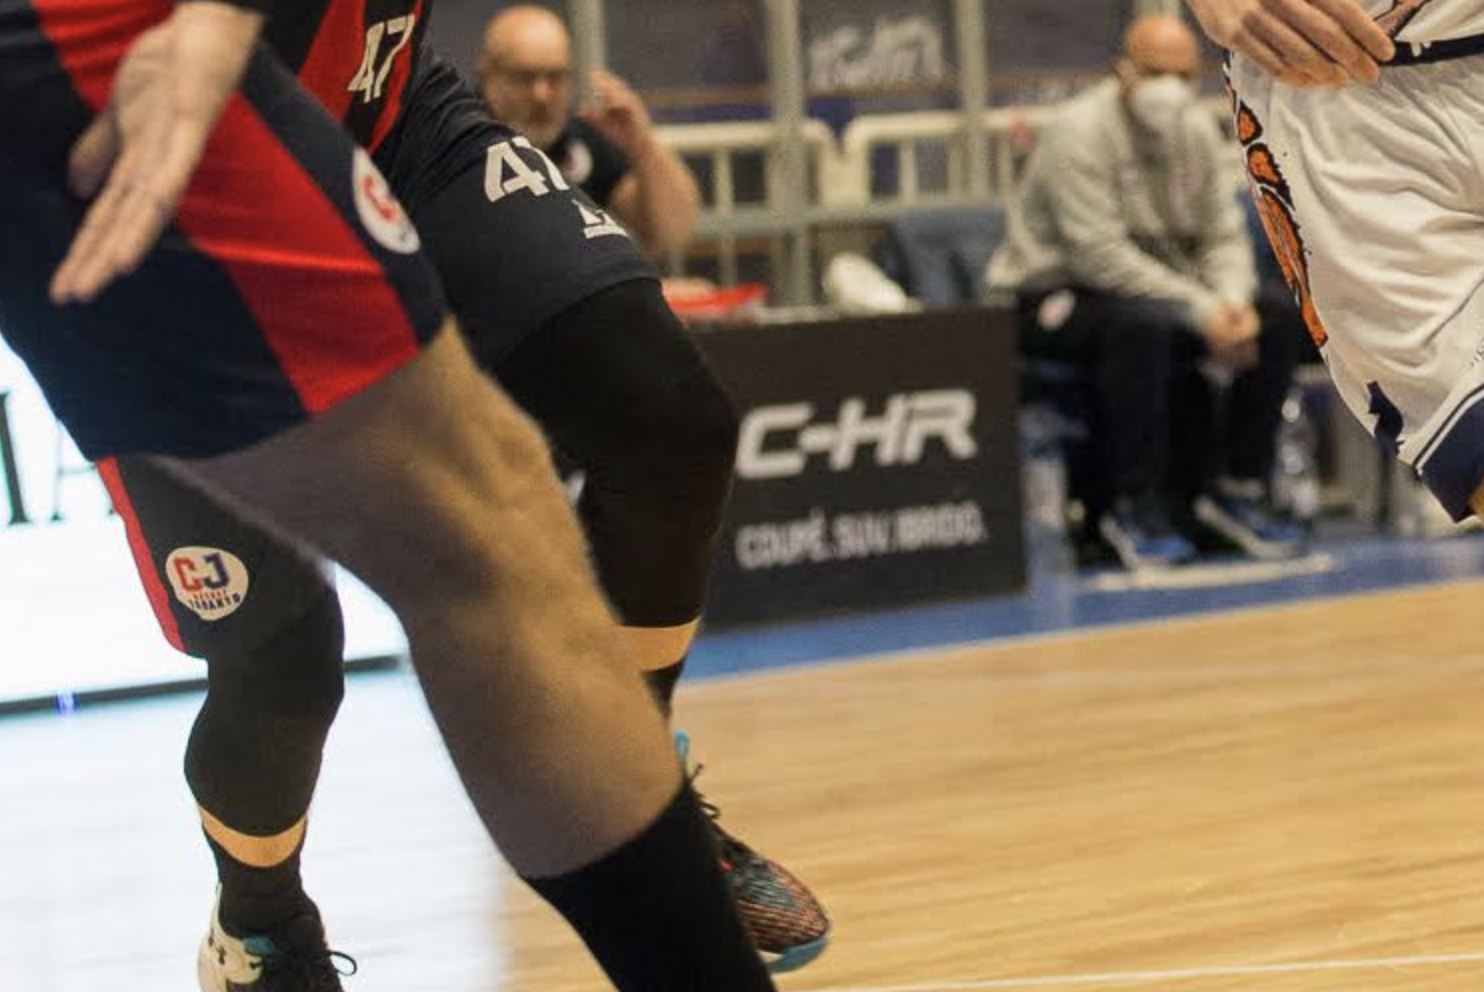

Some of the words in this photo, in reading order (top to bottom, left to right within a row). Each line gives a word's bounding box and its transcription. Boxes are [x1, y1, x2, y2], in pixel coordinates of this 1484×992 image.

[347, 13, 415, 103] 47
[737, 389, 977, 479] C-HR
[173, 552, 229, 591] CJ
